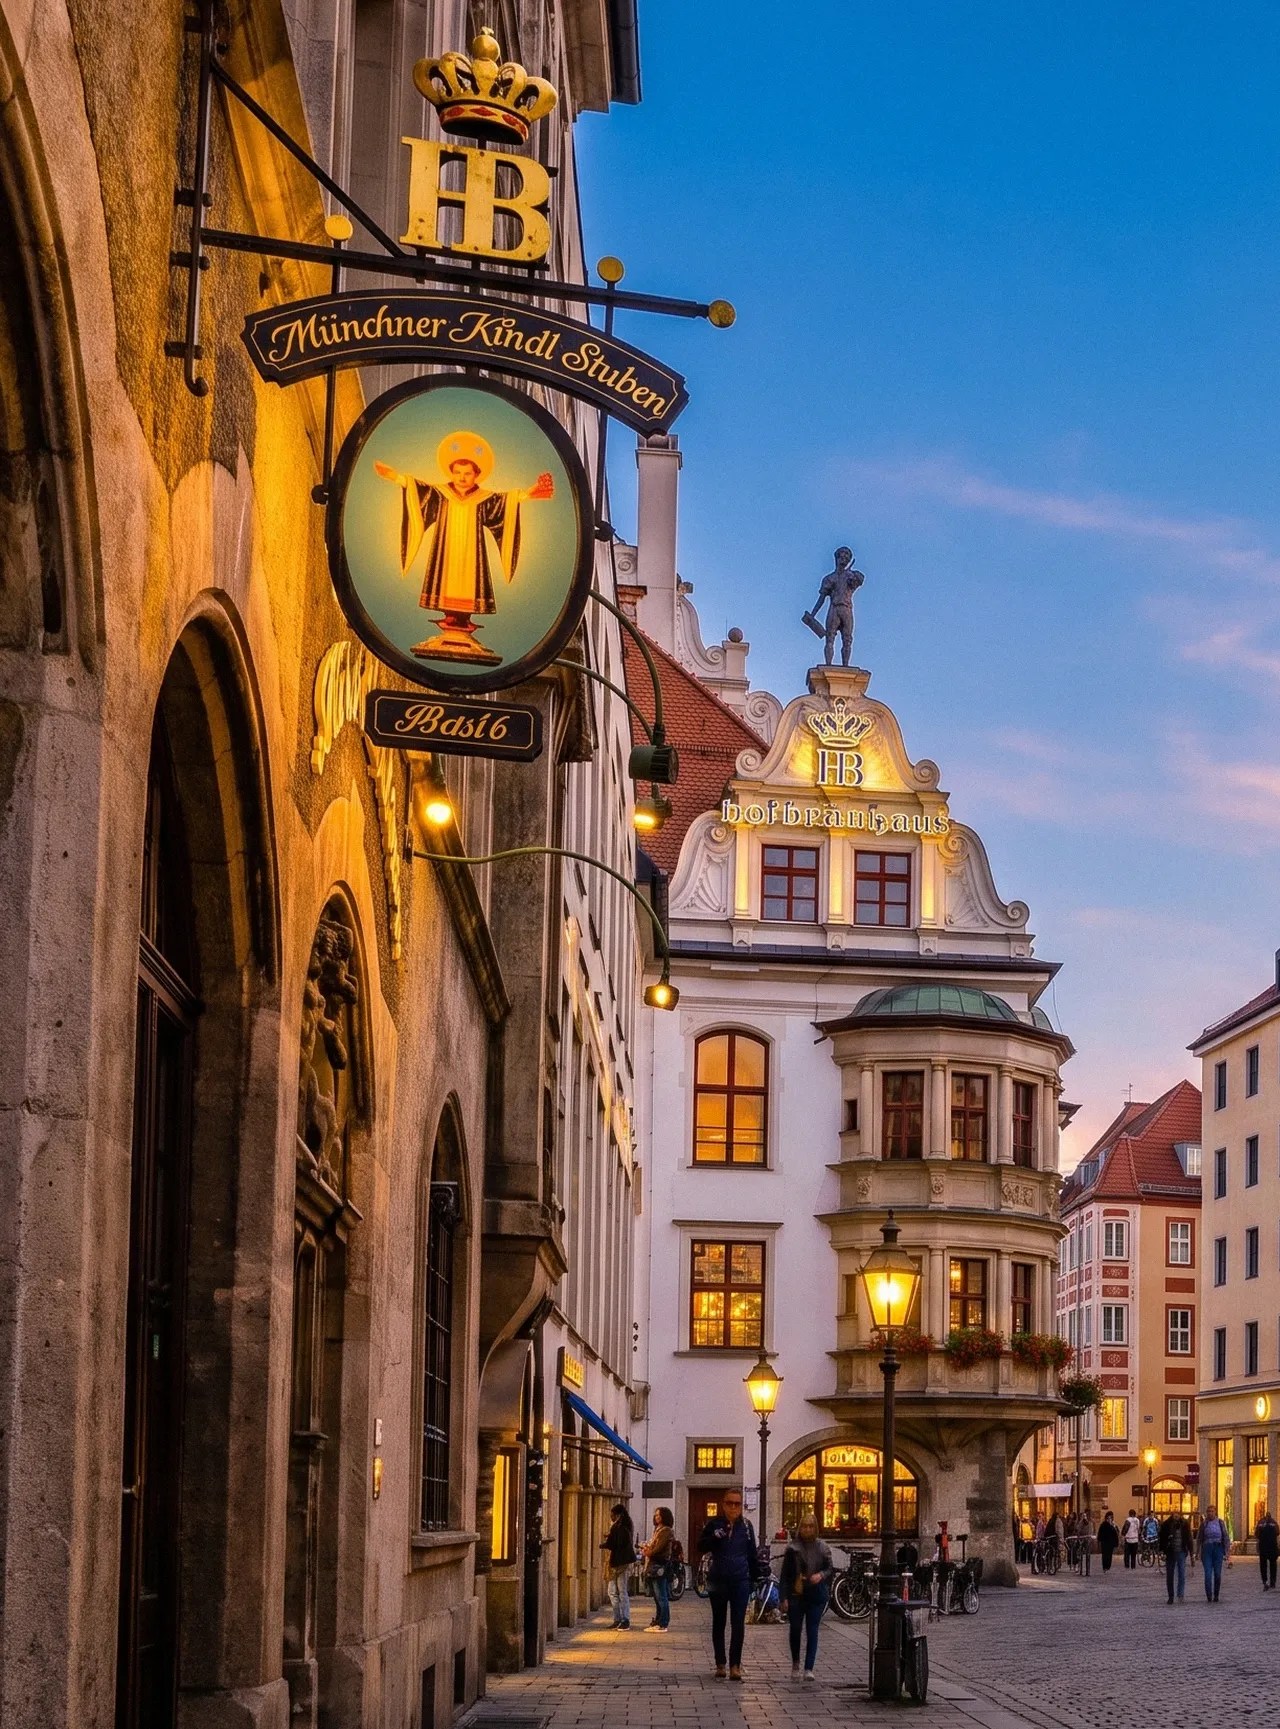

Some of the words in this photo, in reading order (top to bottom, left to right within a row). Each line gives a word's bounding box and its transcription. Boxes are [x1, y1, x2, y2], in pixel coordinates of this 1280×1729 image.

[400, 136, 551, 263] HB
[268, 304, 449, 362] Münchner
[448, 311, 561, 361] Kindl
[561, 342, 668, 417] Stuben
[816, 748, 865, 787] HB
